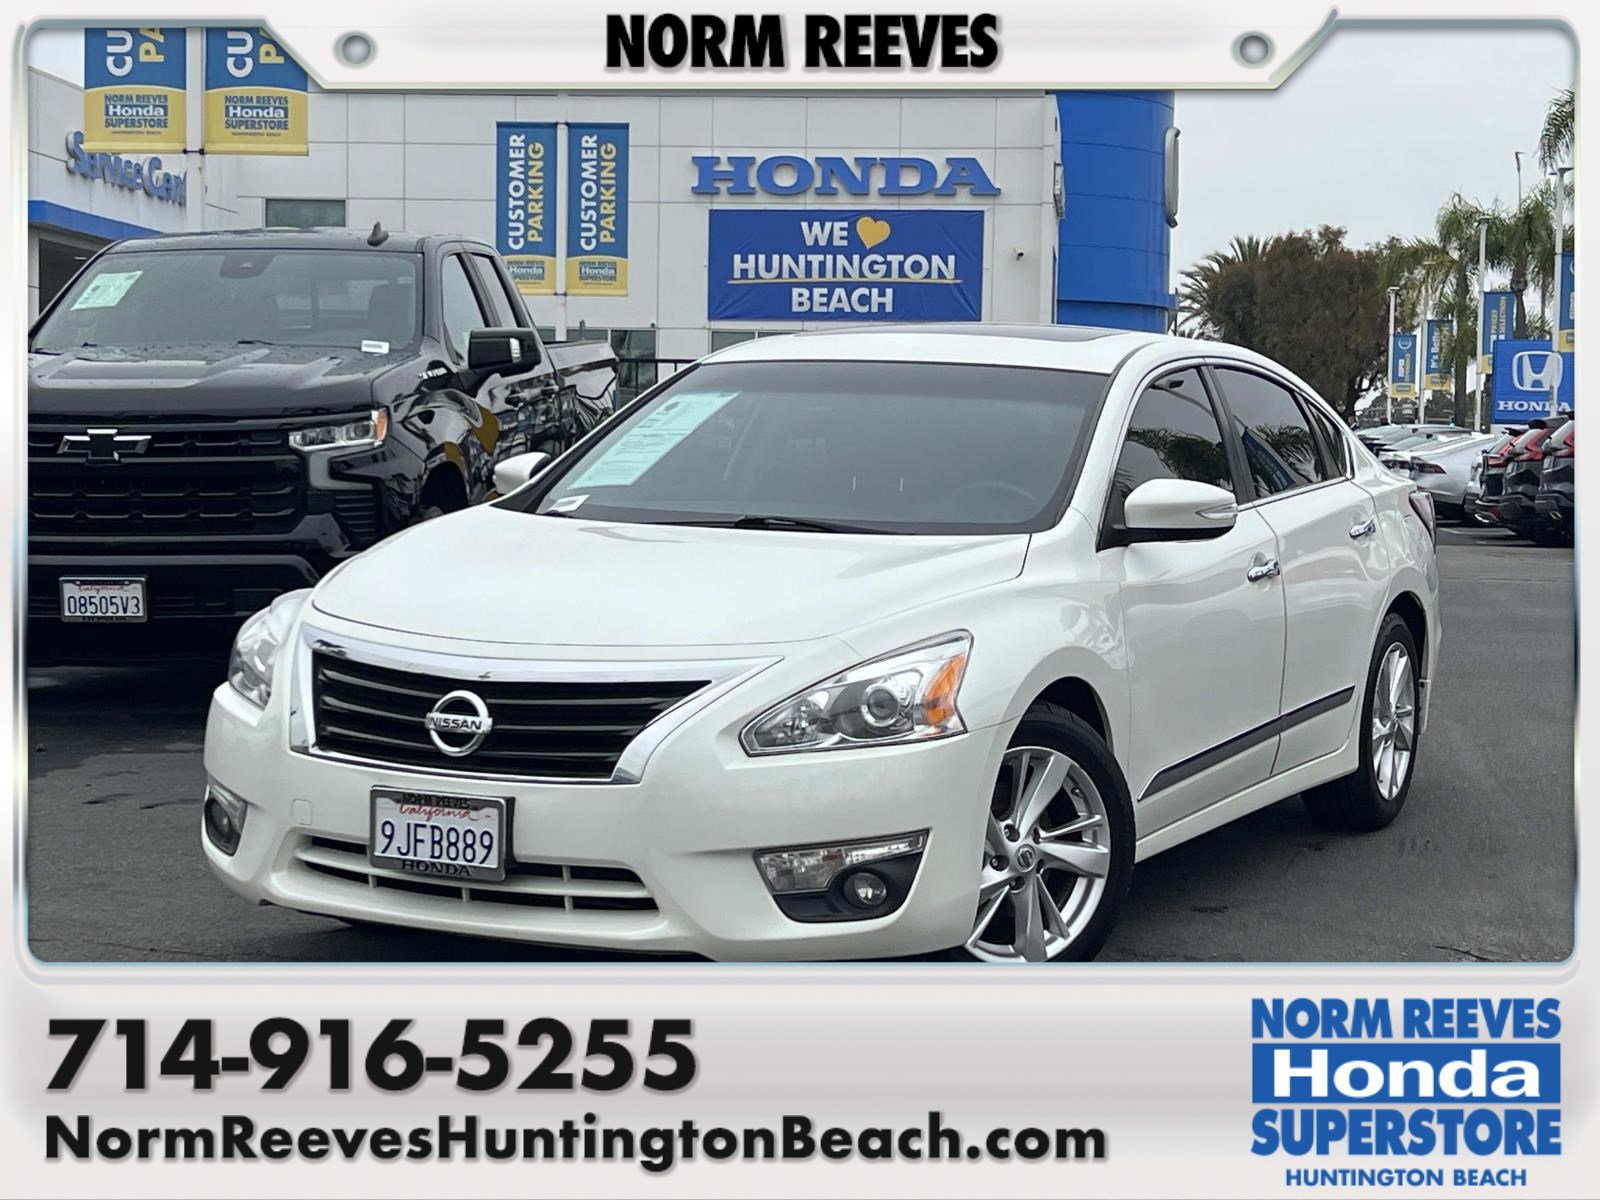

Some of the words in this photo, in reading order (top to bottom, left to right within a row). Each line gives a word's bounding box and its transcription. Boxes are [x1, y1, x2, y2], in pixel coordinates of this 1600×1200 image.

[104, 94, 133, 105] NORM
[136, 94, 169, 105] REEVES
[108, 104, 164, 117] Honda
[224, 95, 254, 106] NORM
[256, 95, 289, 106] REEVES
[104, 118, 169, 129] SUPERSTORE
[228, 106, 285, 119] Honda
[224, 119, 289, 131] SUPERSTORE
[65, 131, 144, 191] Service
[143, 157, 186, 207] Cen
[692, 155, 1002, 196] HONDA
[508, 134, 525, 250] CUSTOMER
[527, 142, 545, 242] PARKING
[580, 134, 598, 251] CUSTOMER
[600, 143, 617, 243] PARKING
[801, 221, 849, 247] WE
[732, 254, 956, 280] HUNTINGTON
[791, 287, 894, 313] BEACH
[67, 595, 141, 615] 08505V3
[428, 716, 483, 731] NISSAN
[399, 801, 472, 821] California
[381, 820, 494, 865] 9JFB889
[401, 859, 472, 877] HONDA
